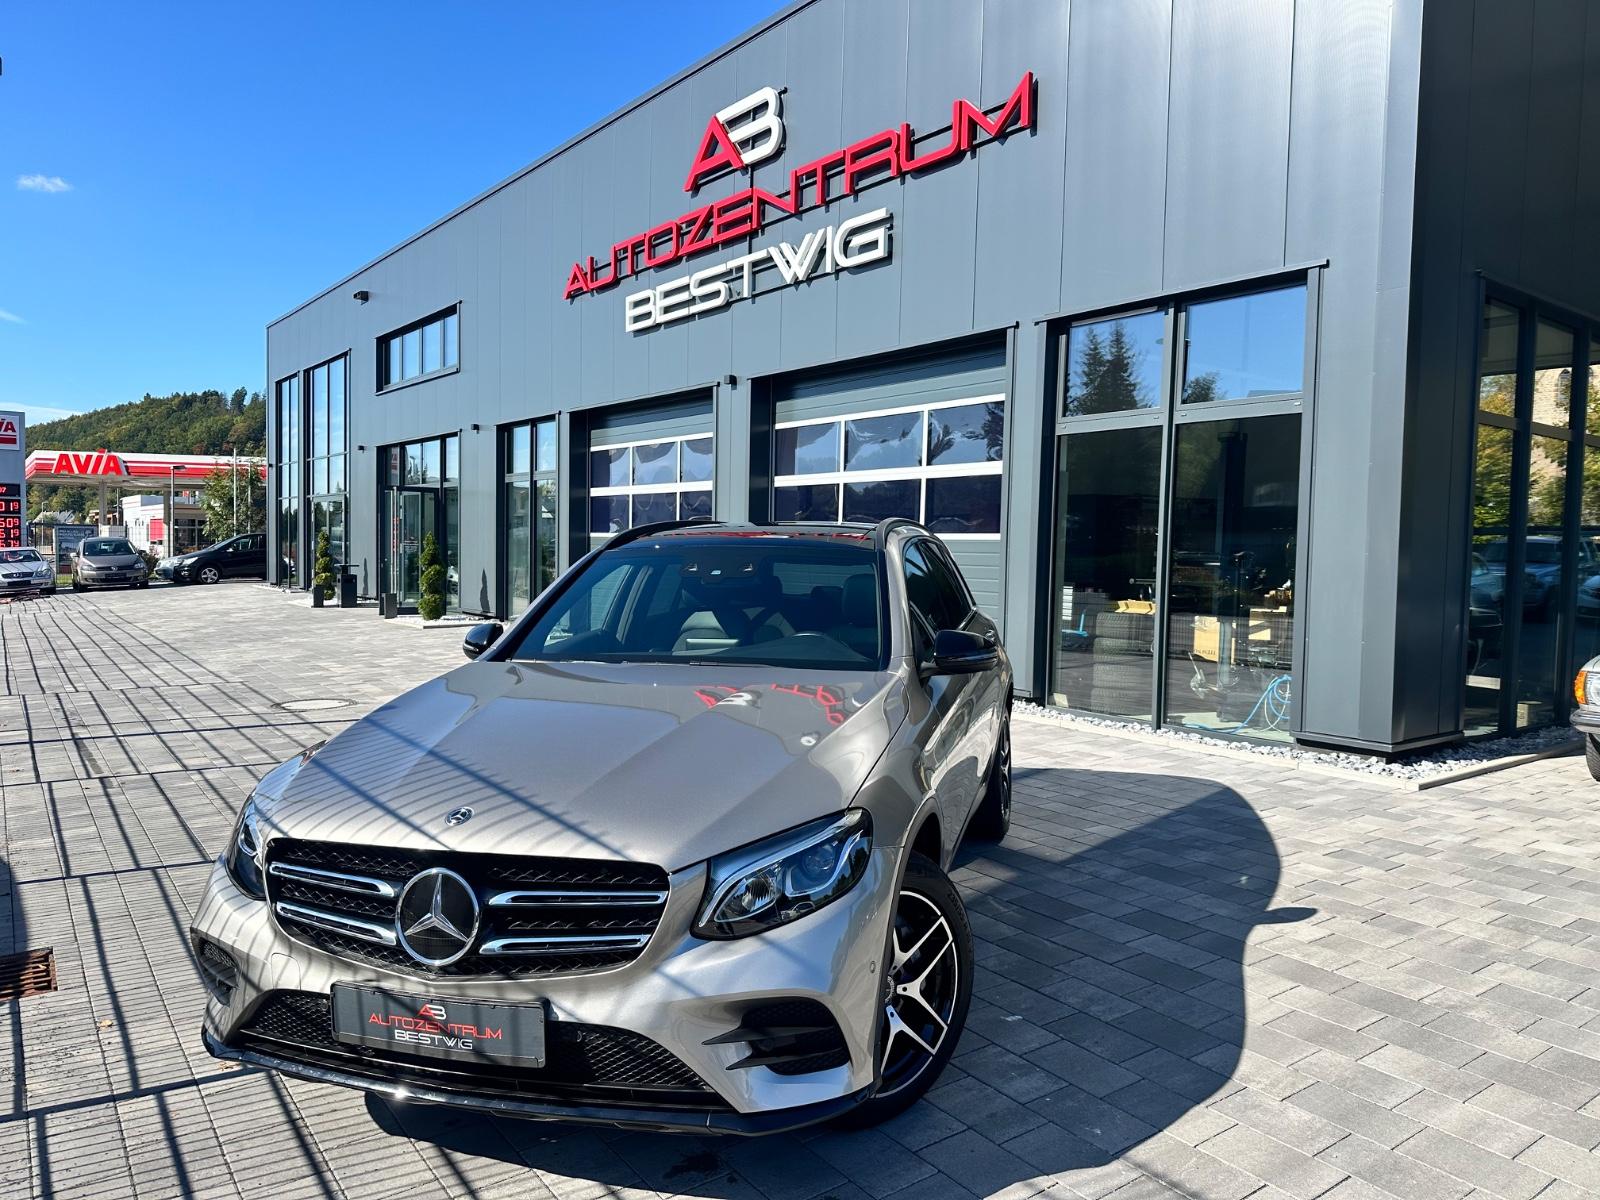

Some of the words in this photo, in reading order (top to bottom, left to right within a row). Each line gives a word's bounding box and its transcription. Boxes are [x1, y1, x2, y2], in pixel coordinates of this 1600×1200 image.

[683, 86, 784, 193] AB
[564, 71, 1034, 301] AUTOZENTRUM
[625, 207, 890, 333] BESTWIG
[53, 448, 123, 476] AVIA
[418, 1003, 447, 1020] AB
[368, 1012, 502, 1040] AUTOZENTRUM
[394, 1029, 473, 1050] BESTWIG
